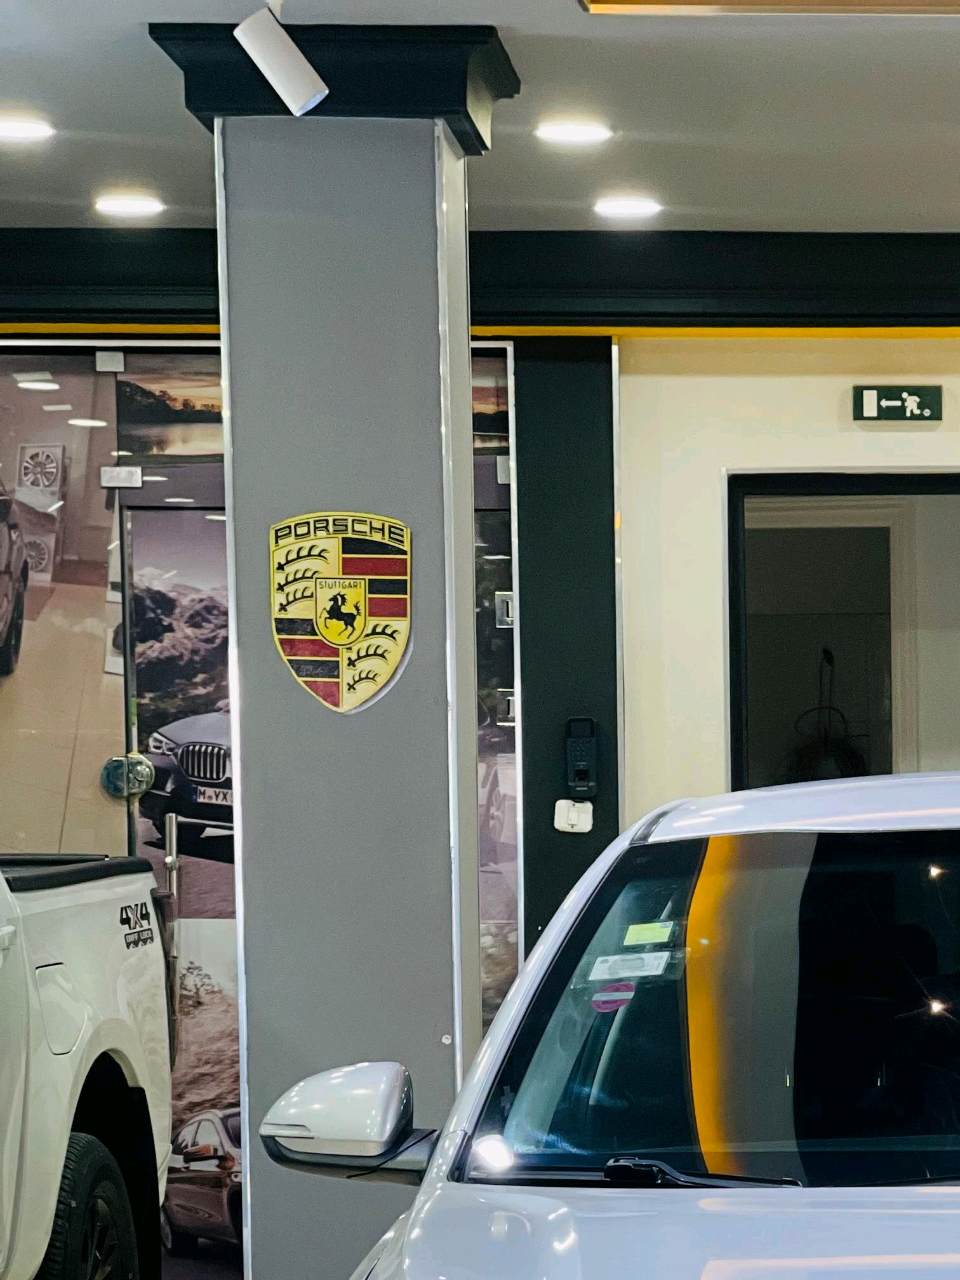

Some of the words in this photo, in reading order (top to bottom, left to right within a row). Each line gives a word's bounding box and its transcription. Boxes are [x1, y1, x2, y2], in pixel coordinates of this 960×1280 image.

[275, 518, 405, 547] PORSCHE
[319, 581, 362, 590] STUTTGART
[120, 902, 150, 930] 4X4
